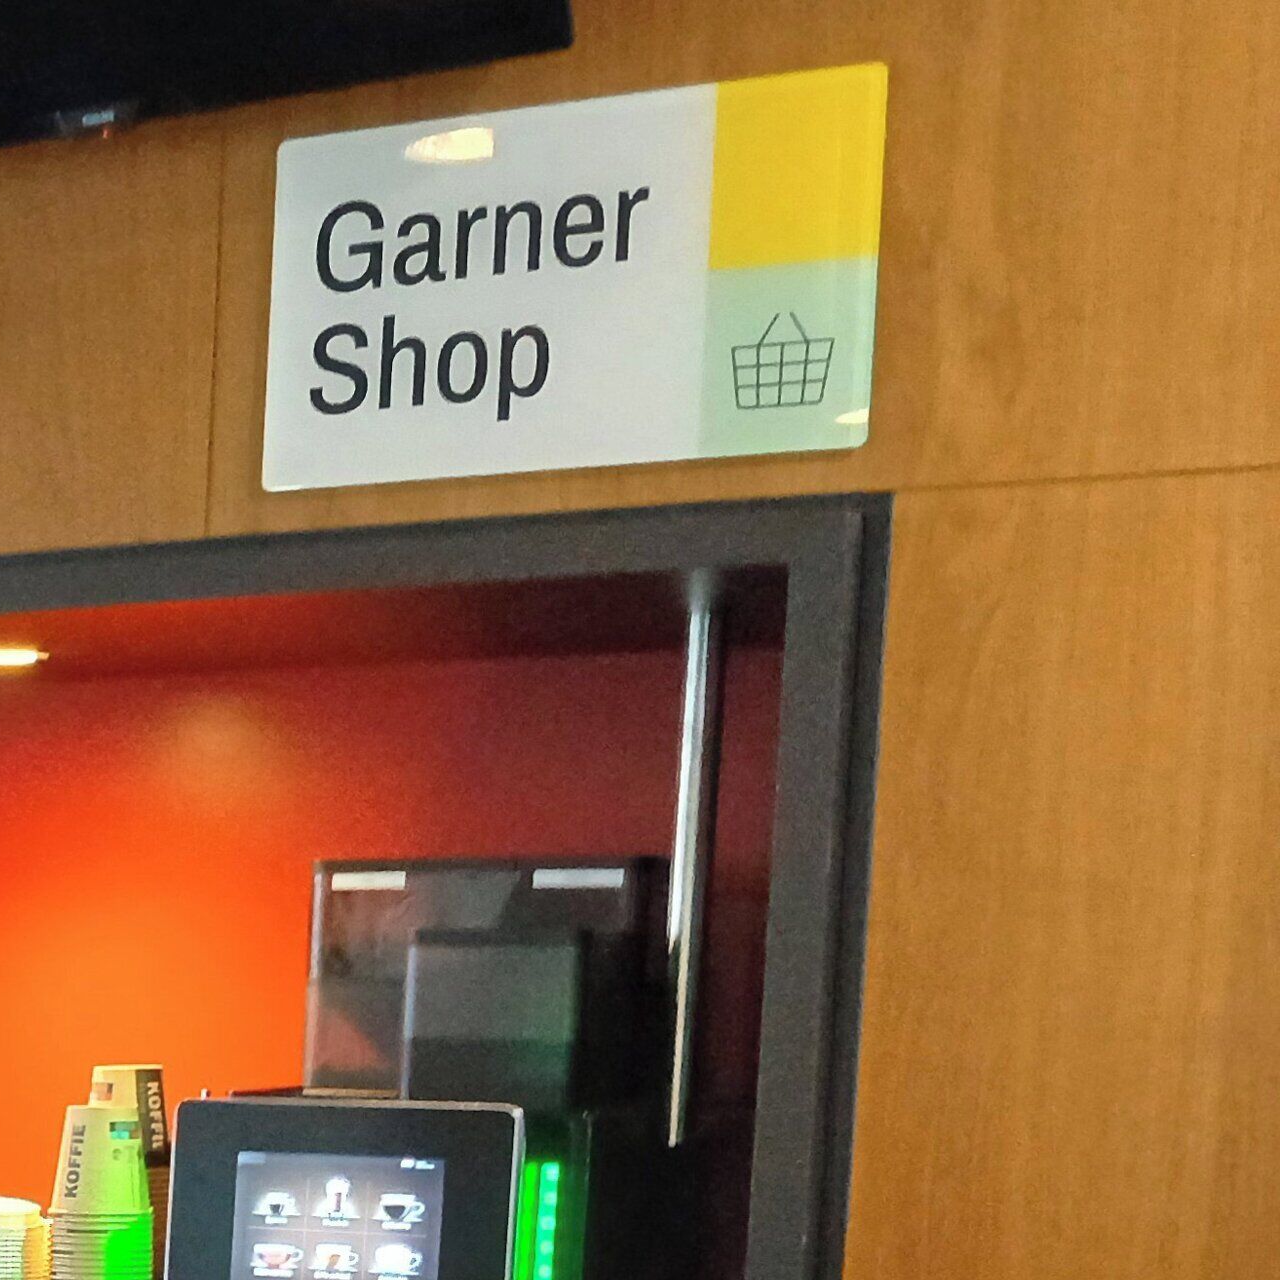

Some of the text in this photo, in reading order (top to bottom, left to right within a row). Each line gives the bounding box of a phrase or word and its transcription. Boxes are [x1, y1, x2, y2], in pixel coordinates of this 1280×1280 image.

[315, 186, 650, 294] Garner
[308, 314, 550, 423] Shop
[64, 1124, 87, 1199] KOFFIE
